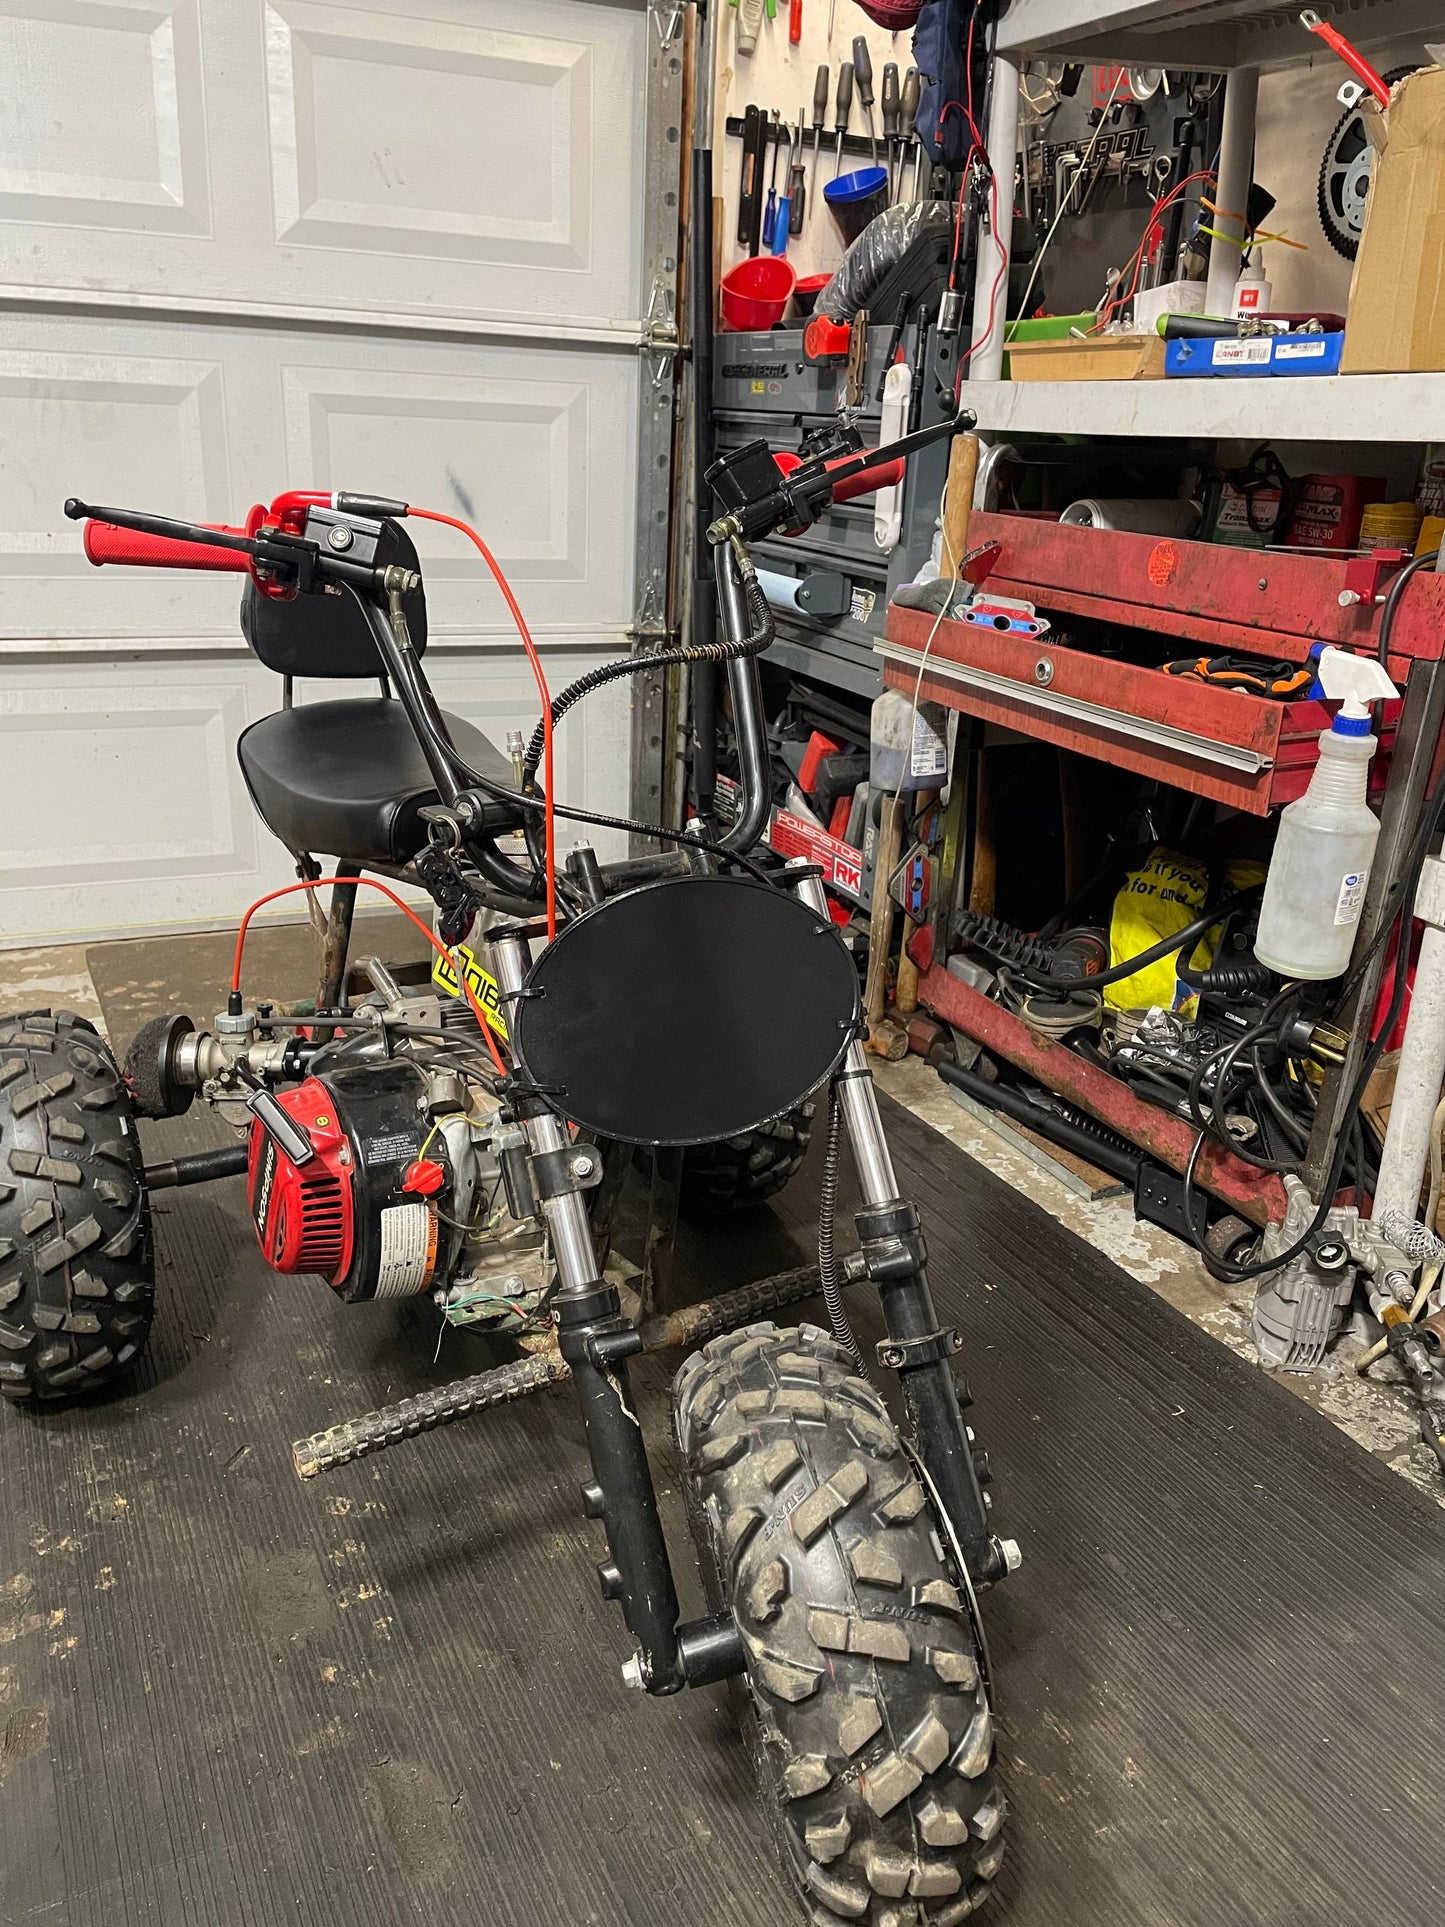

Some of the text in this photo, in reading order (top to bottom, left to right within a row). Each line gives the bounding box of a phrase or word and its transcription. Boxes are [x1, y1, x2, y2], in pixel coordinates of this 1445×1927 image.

[1308, 527, 1334, 540] 5W-30
[778, 812, 863, 863] POWERSTOP
[835, 860, 861, 890] RK
[1130, 877, 1158, 896] for
[1167, 867, 1204, 893] you
